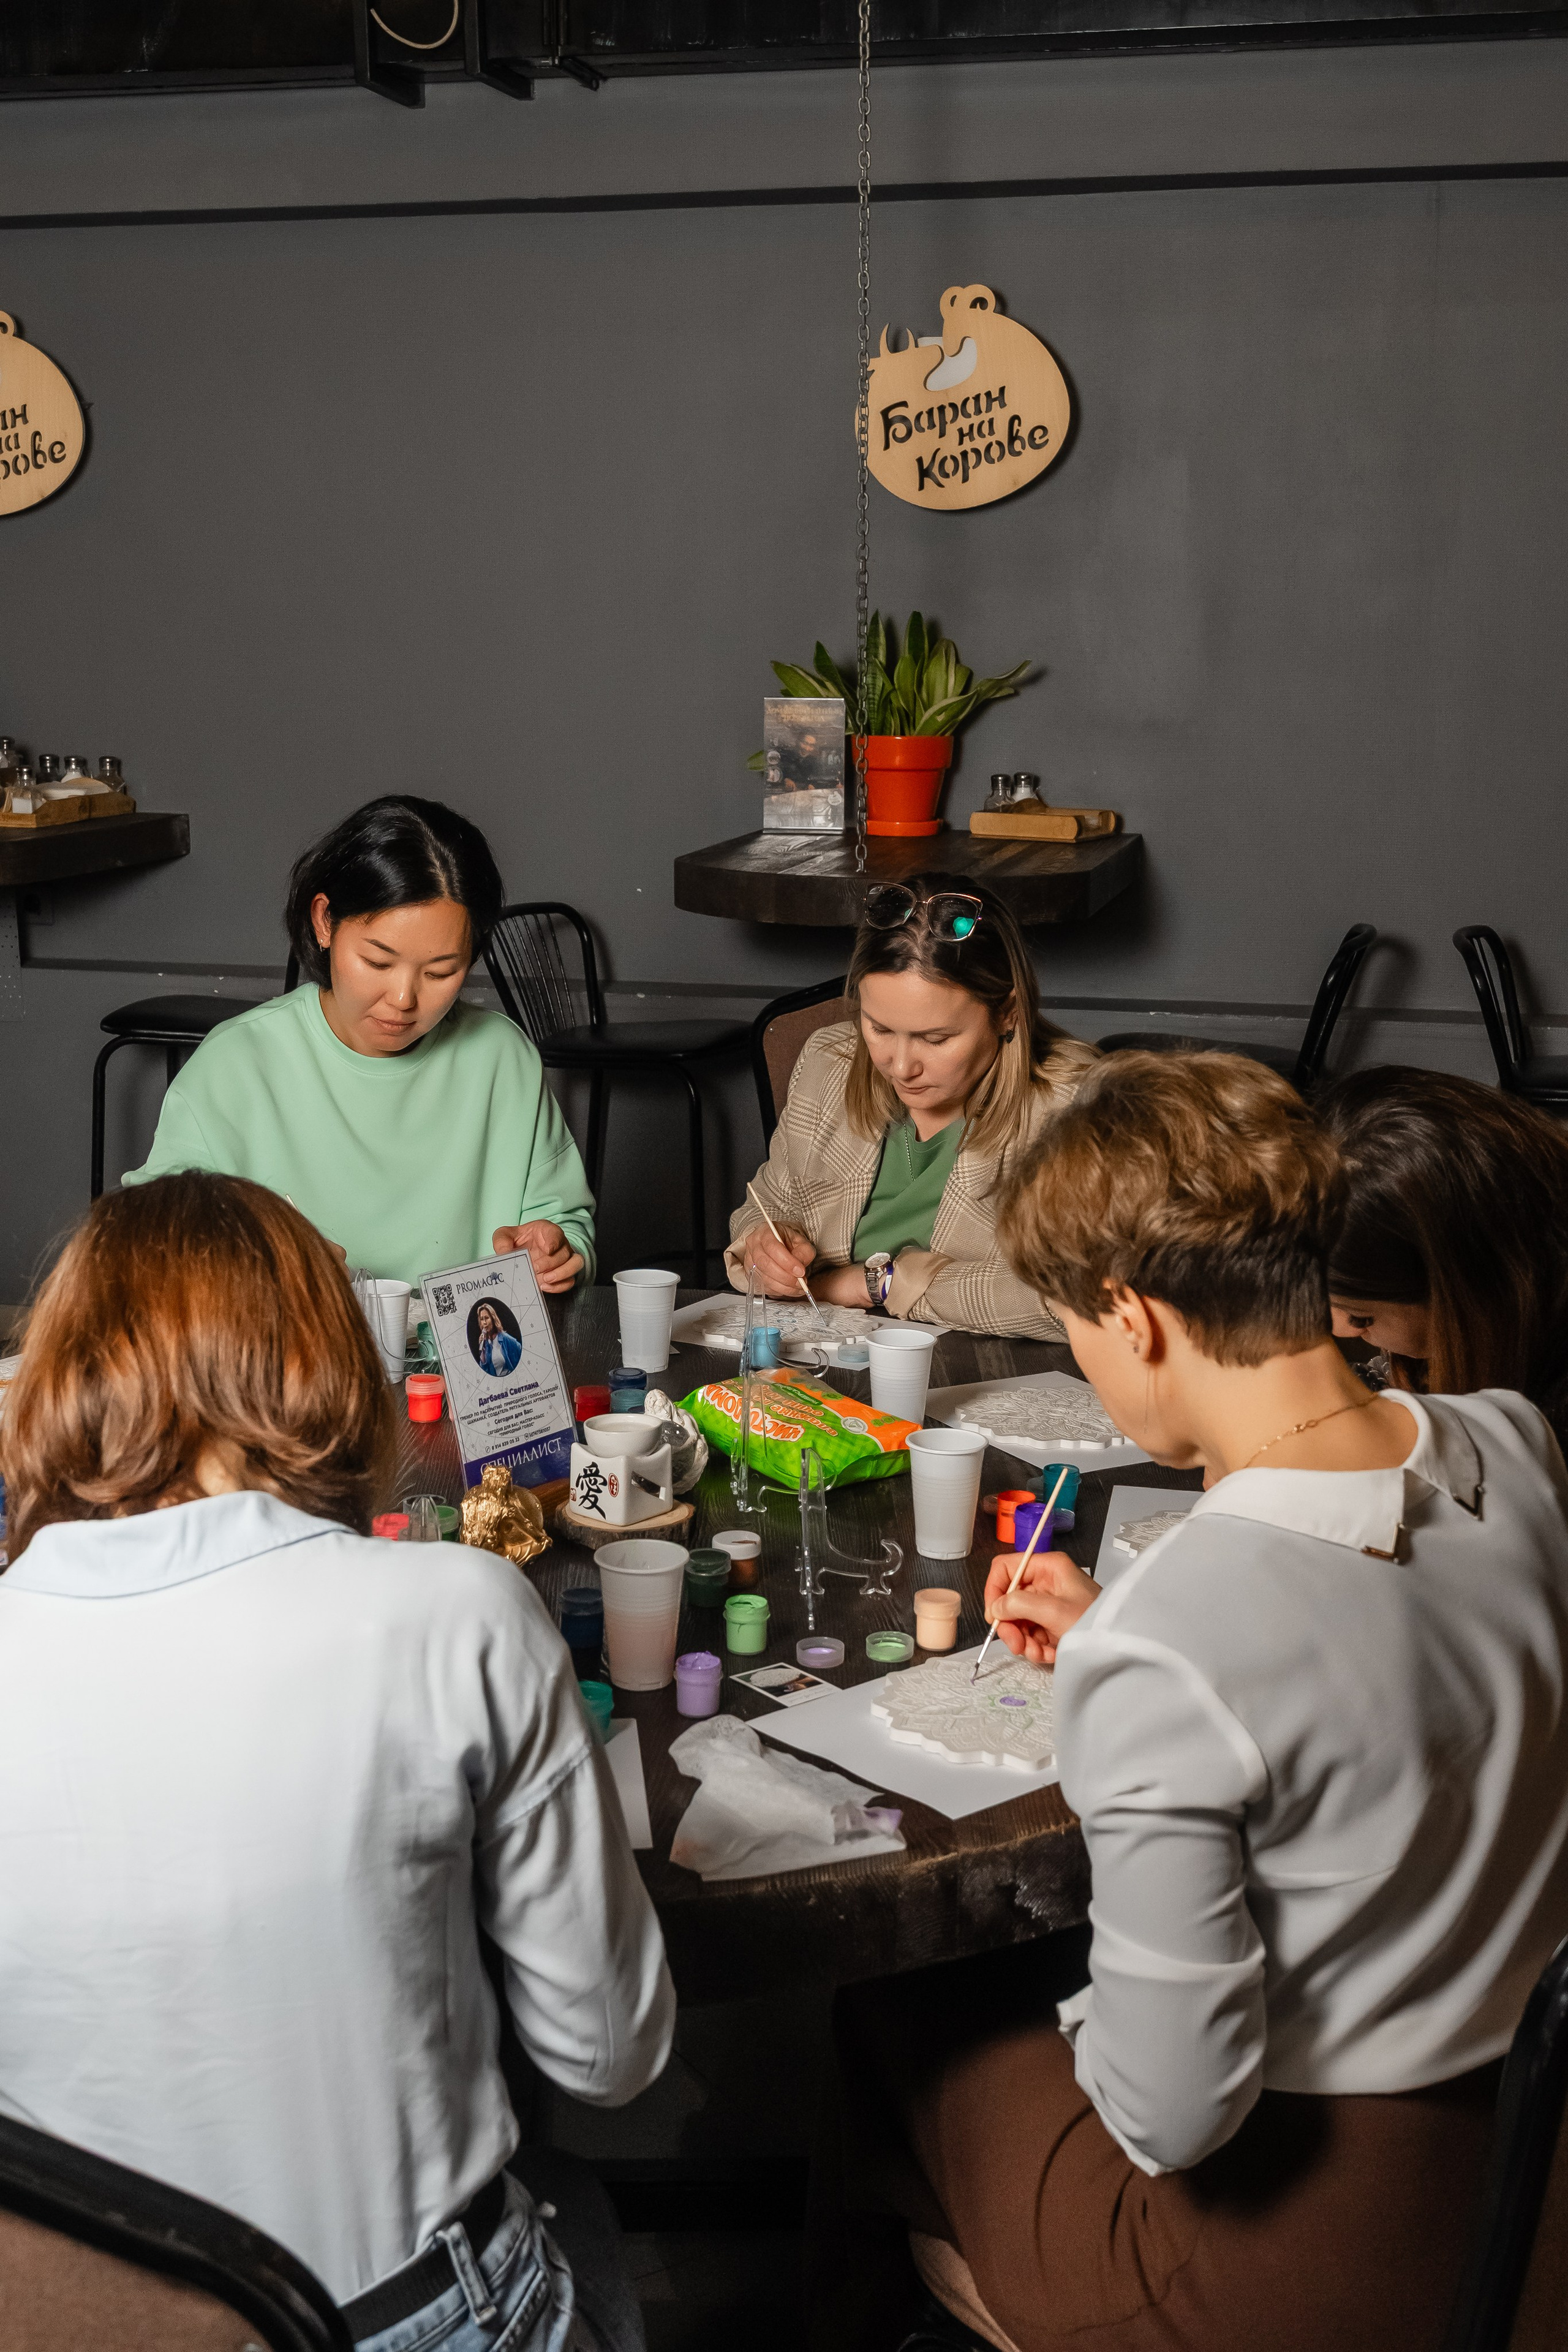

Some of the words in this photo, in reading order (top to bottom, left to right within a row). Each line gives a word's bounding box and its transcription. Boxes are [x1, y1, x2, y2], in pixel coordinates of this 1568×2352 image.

[880, 385, 1007, 451] Баран
[957, 417, 996, 446] на
[915, 414, 1049, 492] Корове
[456, 1272, 505, 1294] PROMAGIC
[478, 1392, 508, 1407] Дагбаева
[509, 1381, 539, 1396] Светлана
[480, 1404, 503, 1415] РАСКРЫТИЮ
[503, 1396, 527, 1408] ПРИРОДНОГО
[488, 1408, 509, 1418] СОЗДАТЕЛЬ
[509, 1400, 532, 1411] РИТУАЛЬНЫХ
[533, 1393, 556, 1404] АРТЕФАКТОВ
[488, 1427, 503, 1436] СЕГОДНЯ
[519, 1413, 545, 1425] МАСТЕР-КЛАСС
[494, 1415, 514, 1425] Сегодня
